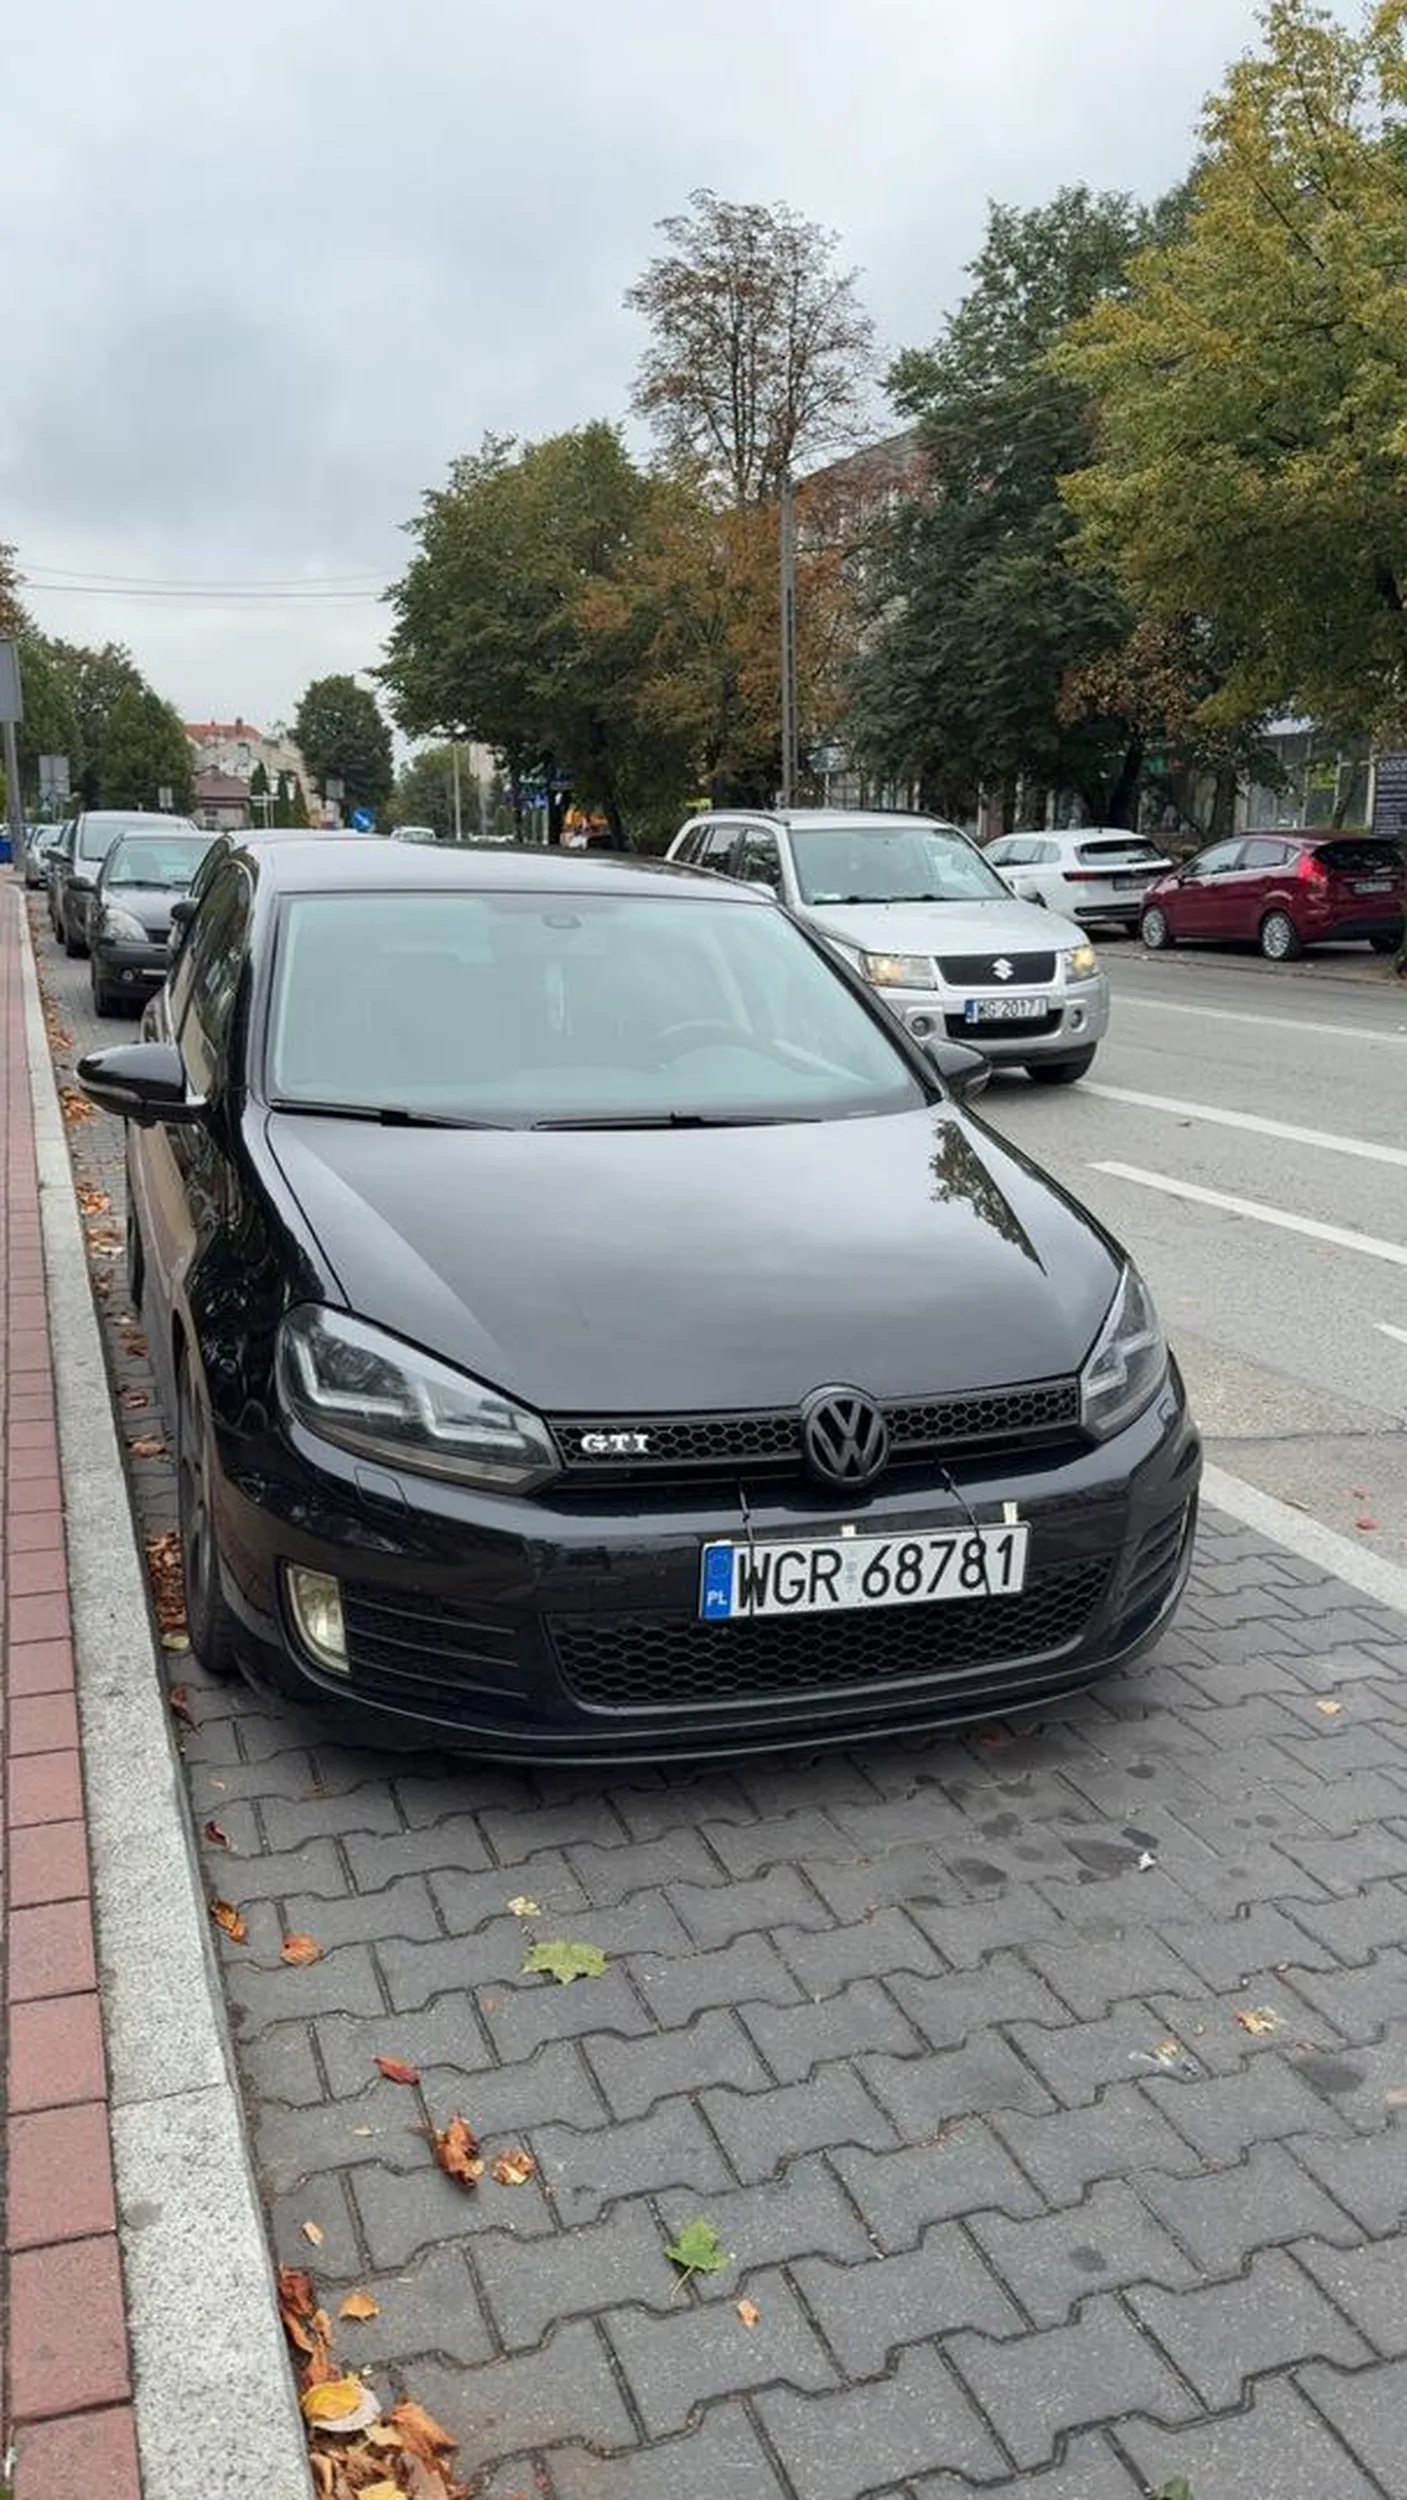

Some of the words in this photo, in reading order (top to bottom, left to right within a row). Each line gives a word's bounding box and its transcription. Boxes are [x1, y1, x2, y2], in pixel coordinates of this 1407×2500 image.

[581, 1434, 649, 1453] GTI
[738, 1549, 842, 1608] WGR
[862, 1534, 1013, 1598] 68781
[707, 1590, 728, 1607] PL
